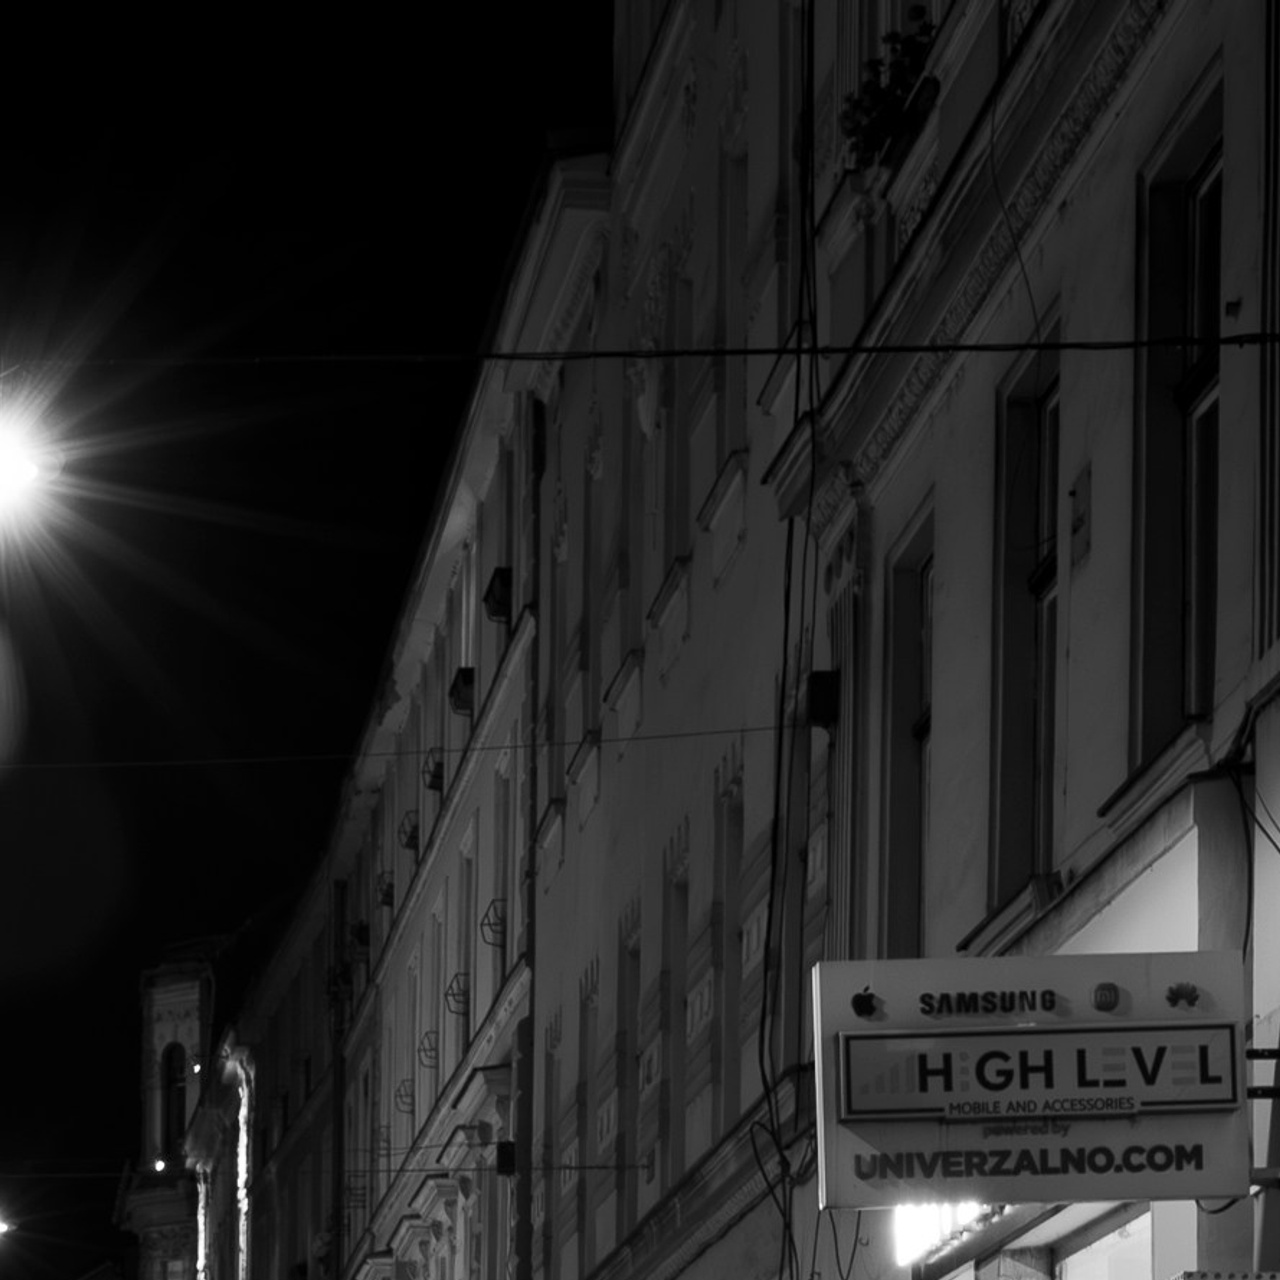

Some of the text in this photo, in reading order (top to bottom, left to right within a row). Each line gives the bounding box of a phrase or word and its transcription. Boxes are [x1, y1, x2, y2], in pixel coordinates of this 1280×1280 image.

[920, 989, 1057, 1015] SAMSUNG
[919, 1045, 1222, 1092] HIGH LEVEL
[948, 1096, 1135, 1115] MOBILE AND ACCESSORIES
[1051, 1119, 1070, 1138] by
[853, 1144, 1204, 1180] UNIVERZALNO.COM
